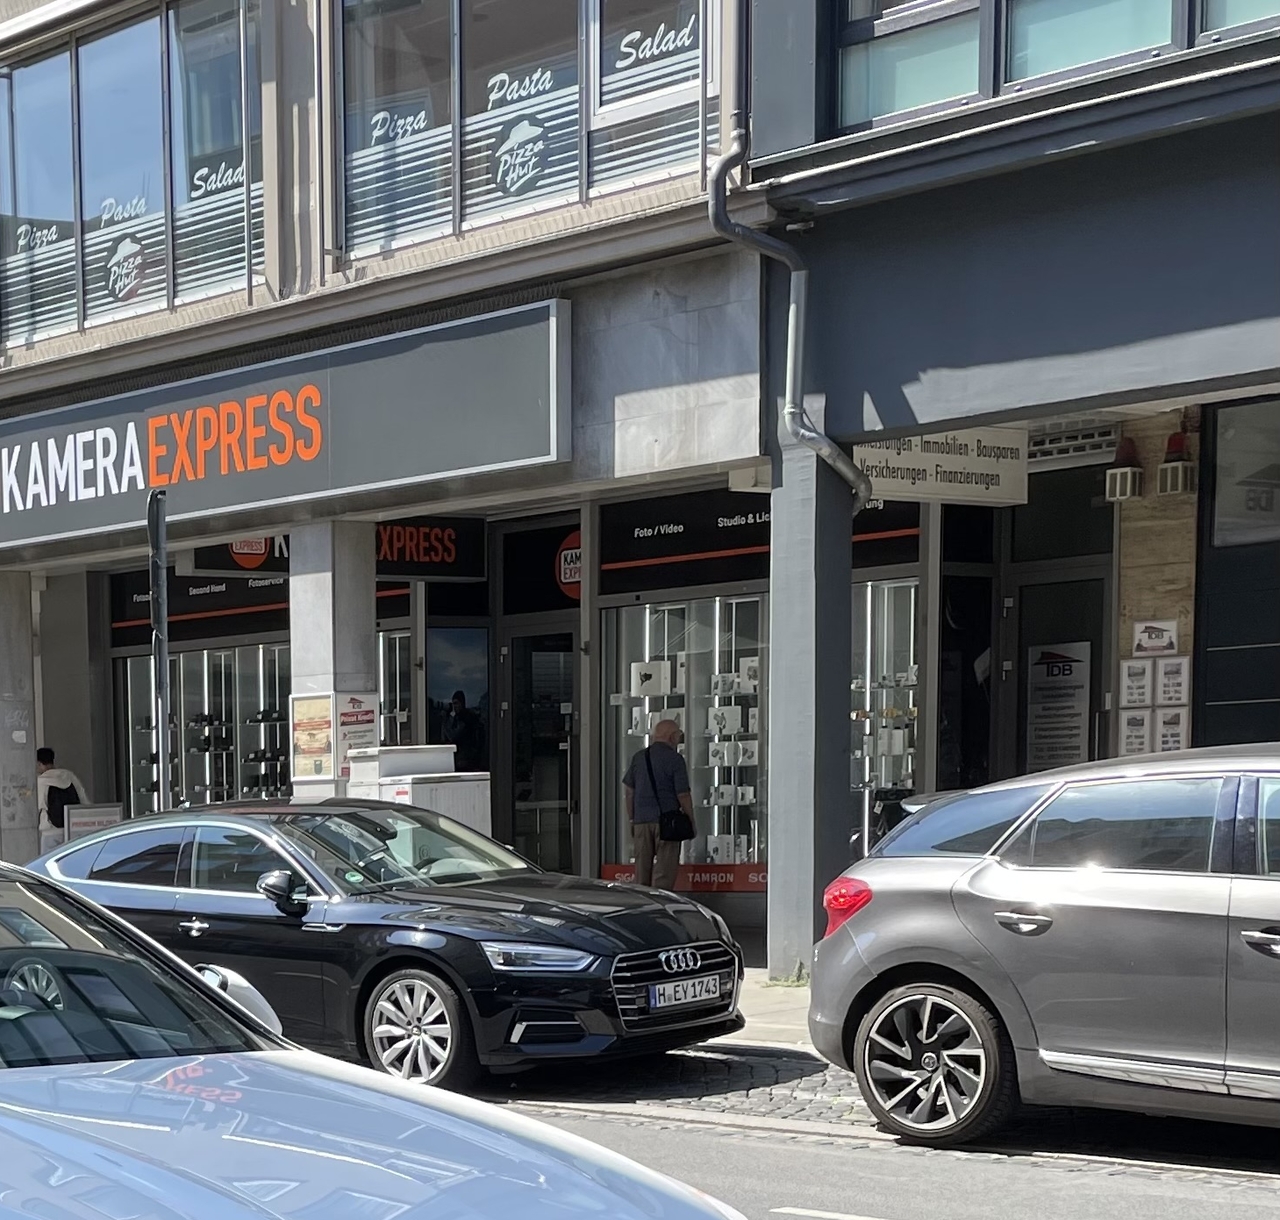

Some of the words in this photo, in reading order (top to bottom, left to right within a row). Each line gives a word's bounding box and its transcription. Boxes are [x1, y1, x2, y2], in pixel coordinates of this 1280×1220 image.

[615, 14, 696, 69] Salad
[487, 68, 553, 110] Pasta
[371, 109, 428, 145] Pizza
[497, 140, 545, 183] Pizza
[505, 157, 537, 188] Hut
[191, 161, 246, 199] Salad
[101, 196, 148, 228] Pasta
[16, 224, 58, 253] Pizza
[109, 255, 142, 289] Pizza
[115, 268, 137, 294] Hut
[1, 421, 145, 514] KAMERA
[147, 384, 323, 488] EXPRESS
[920, 435, 969, 457] Immobilien
[976, 439, 1020, 463] Bausparen
[860, 457, 927, 486] Versicherungen
[934, 463, 1001, 491] Finanzierungen
[863, 499, 884, 510] ung
[633, 527, 654, 538] Foto
[659, 524, 684, 535] Video
[717, 514, 746, 527] Studio
[746, 514, 755, 524] &
[756, 512, 770, 523] Lic
[376, 526, 457, 563] XPRESS
[563, 551, 581, 566] KAM
[563, 567, 581, 580] EXP
[1046, 663, 1073, 678] TDB
[614, 873, 635, 883] SIG
[687, 872, 734, 883] TAMRON
[748, 872, 767, 883] SO
[658, 987, 666, 1004] H
